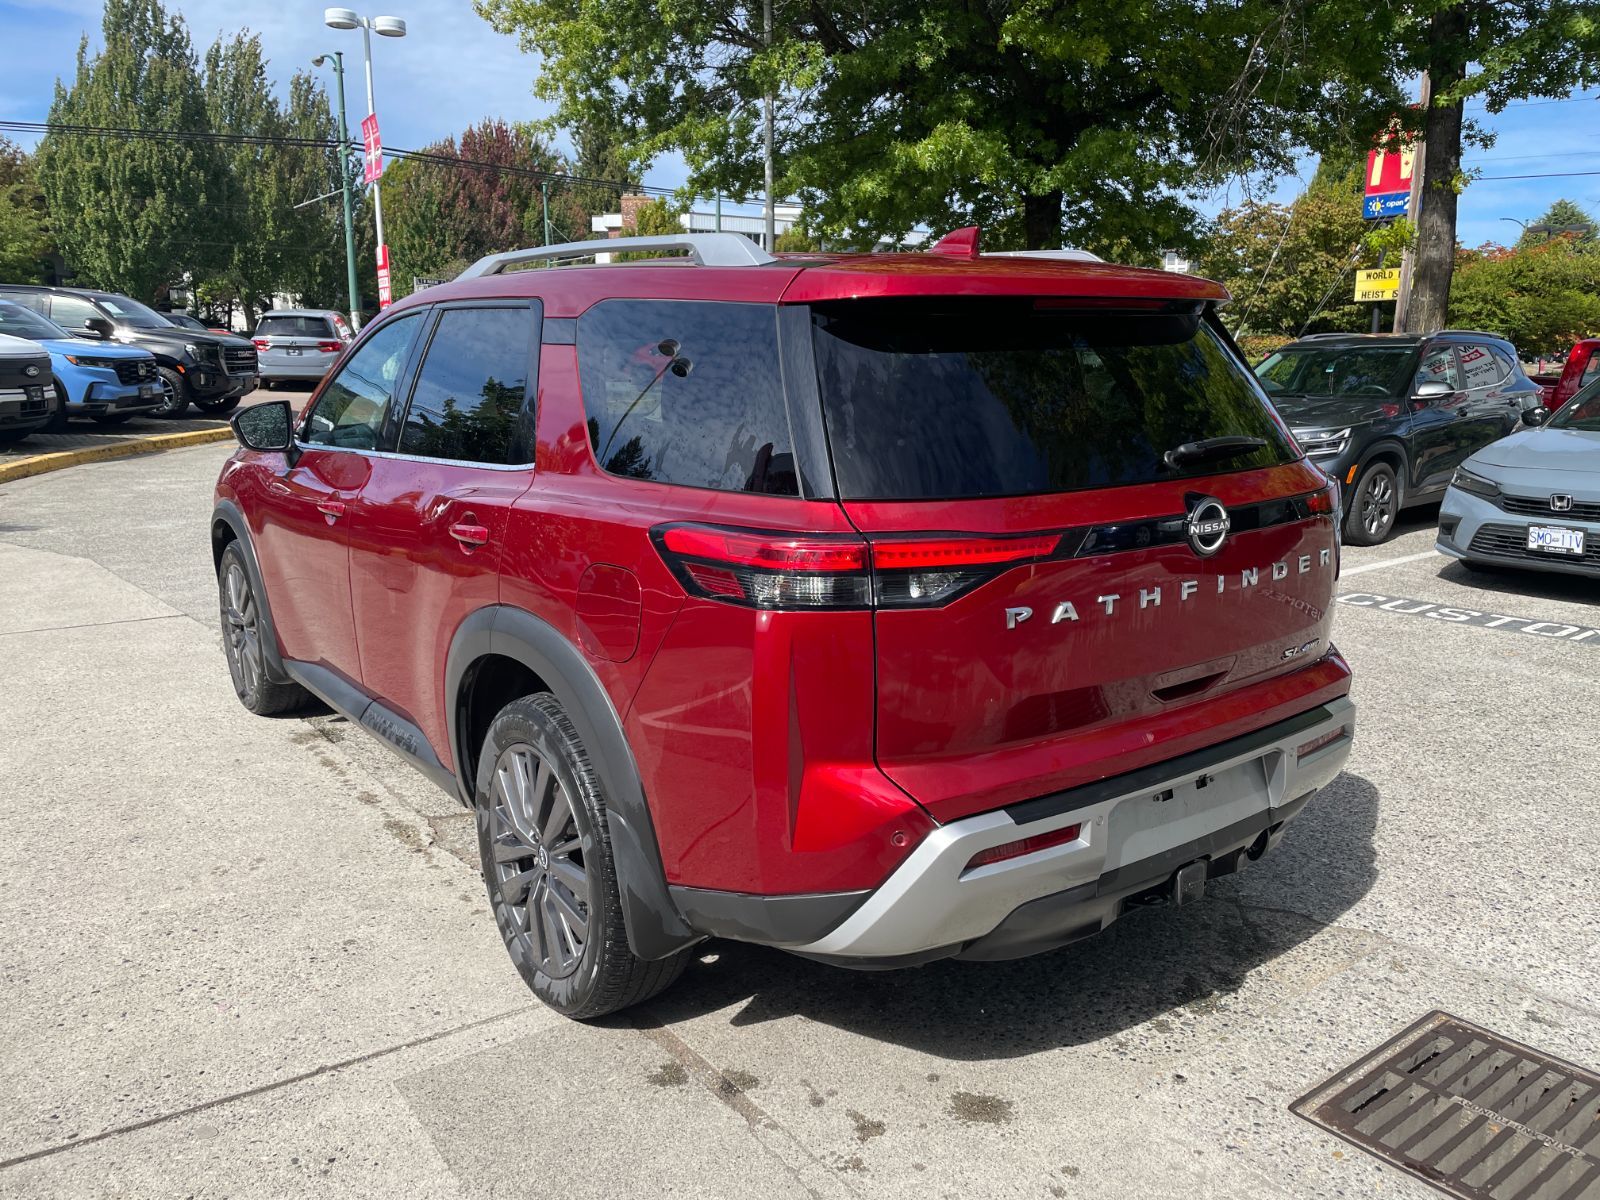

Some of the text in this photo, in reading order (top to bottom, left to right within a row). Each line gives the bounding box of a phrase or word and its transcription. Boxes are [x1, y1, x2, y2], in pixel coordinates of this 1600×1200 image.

[1386, 200, 1404, 209] open
[1365, 271, 1394, 280] WORLD
[1361, 290, 1386, 299] HEIST
[1188, 518, 1231, 535] NISSAN
[1005, 548, 1331, 631] PATHFINDER
